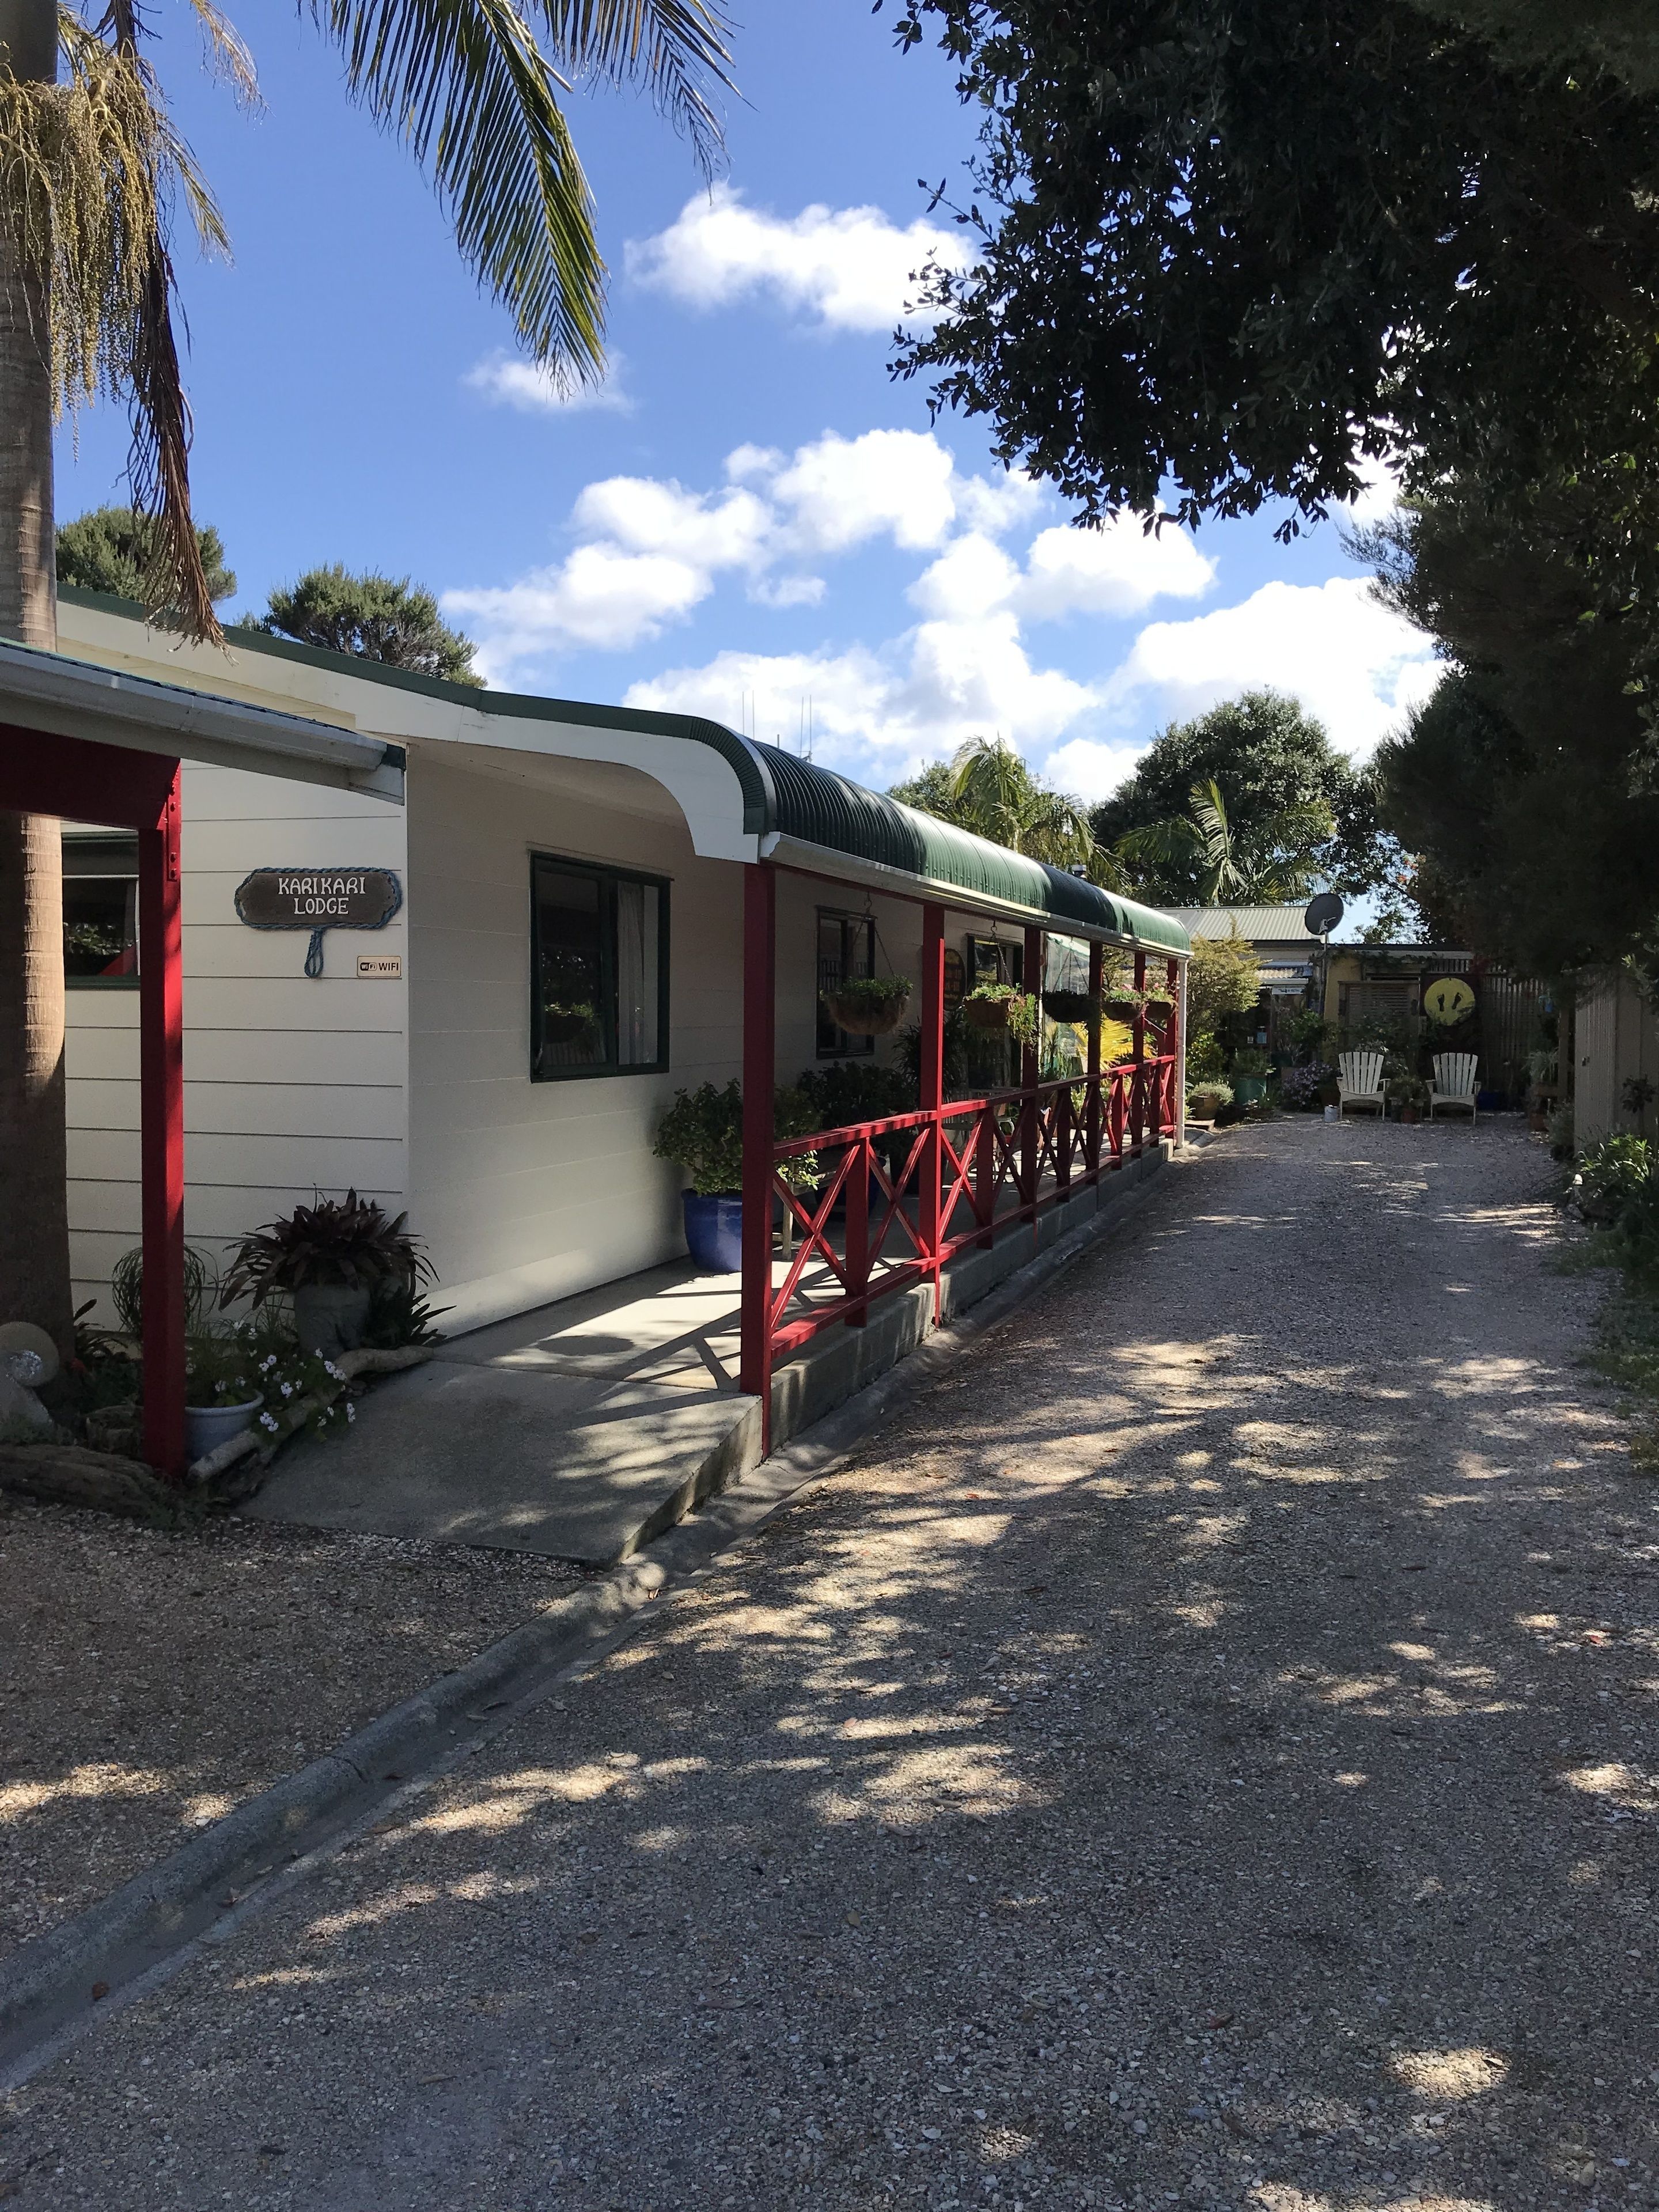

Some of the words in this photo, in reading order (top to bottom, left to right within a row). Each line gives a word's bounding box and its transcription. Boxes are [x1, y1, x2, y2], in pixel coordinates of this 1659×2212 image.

[278, 877, 366, 895] KARIKARI
[294, 897, 349, 915] LODGE
[378, 963, 399, 971] WIFI
